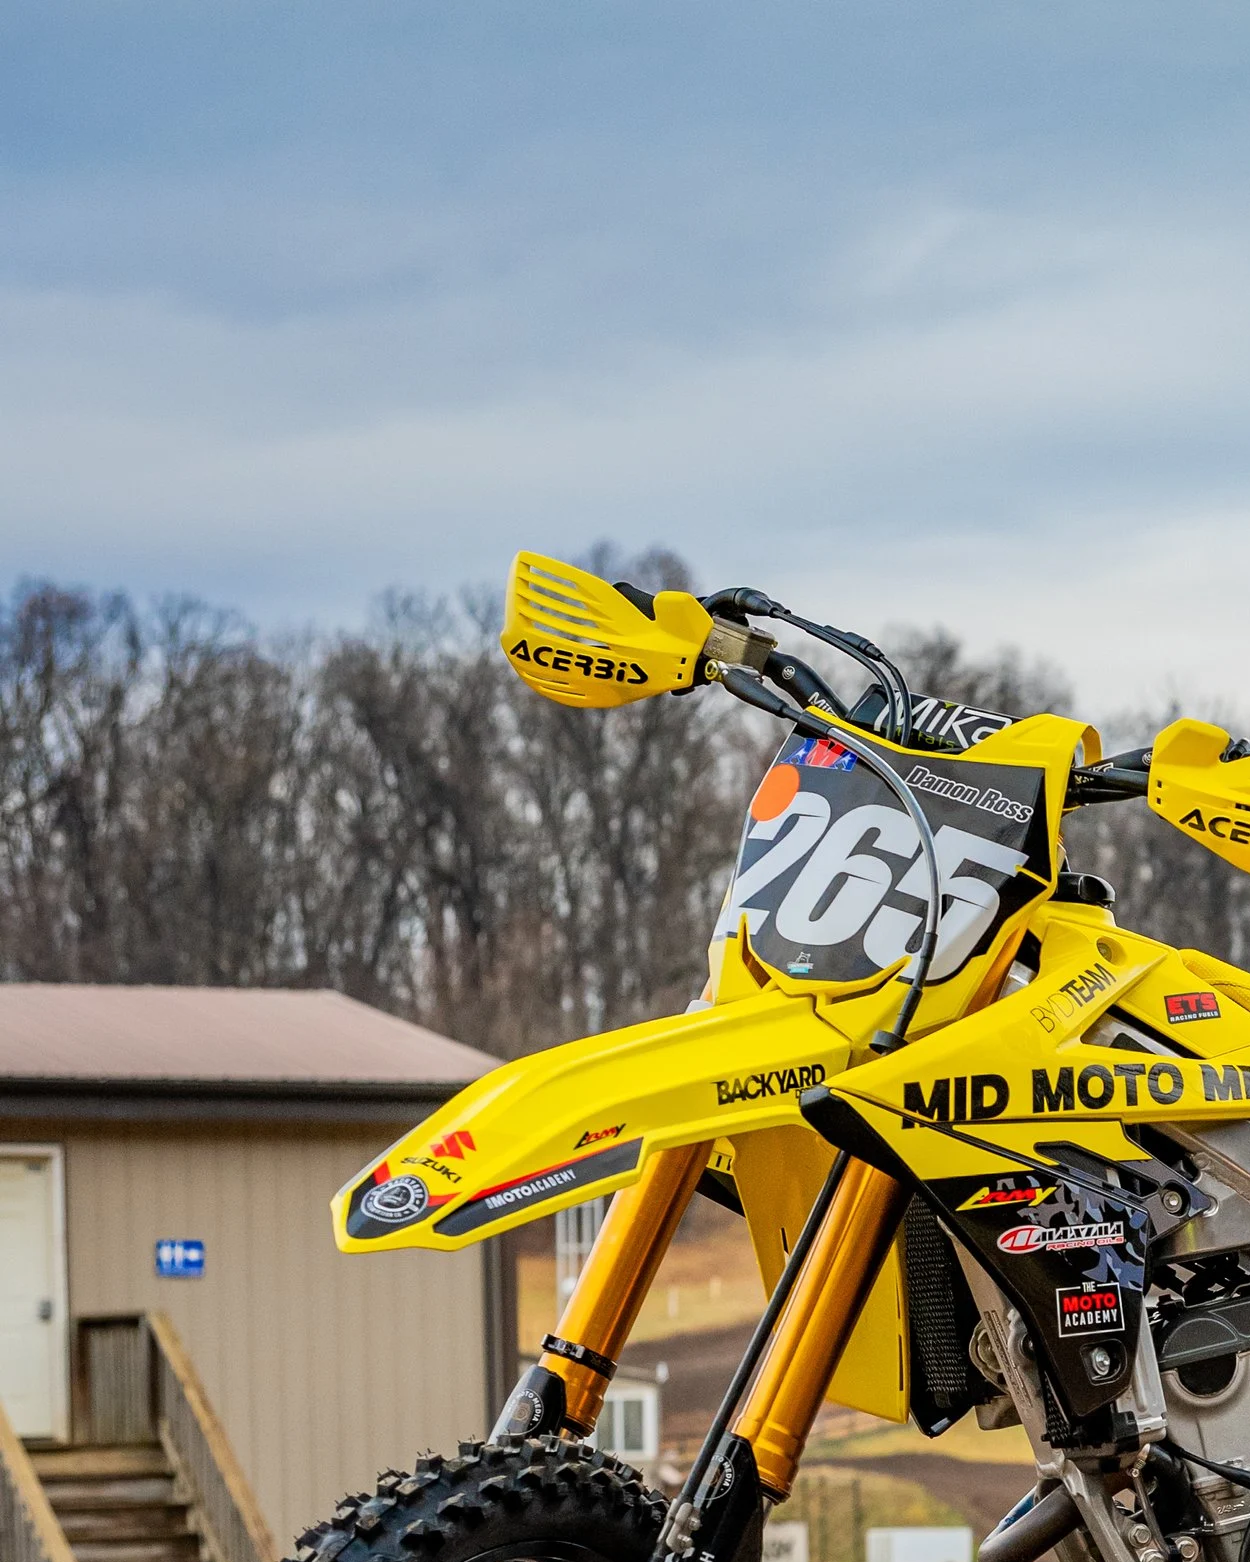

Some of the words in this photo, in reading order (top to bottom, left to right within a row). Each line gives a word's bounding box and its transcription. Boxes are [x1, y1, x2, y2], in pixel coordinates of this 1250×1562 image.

[906, 765, 979, 805] Damon
[976, 788, 1034, 824] Ross
[728, 791, 1030, 980] 265
[1167, 993, 1218, 1014] ETS
[1170, 1013, 1197, 1022] RACING
[711, 1064, 826, 1106] BACKYARD
[902, 1074, 1009, 1130] MID
[1032, 1063, 1184, 1113] MOTO
[400, 1157, 463, 1184] SUZUKI
[1046, 1240, 1095, 1251] RACING
[1096, 1236, 1125, 1246] OILS
[1082, 1281, 1096, 1293] THE
[1063, 1293, 1117, 1313] MOTO
[1064, 1309, 1118, 1327] ACADEMY
[532, 1397, 542, 1422] MEDIA
[722, 1461, 733, 1487] MEDIA
